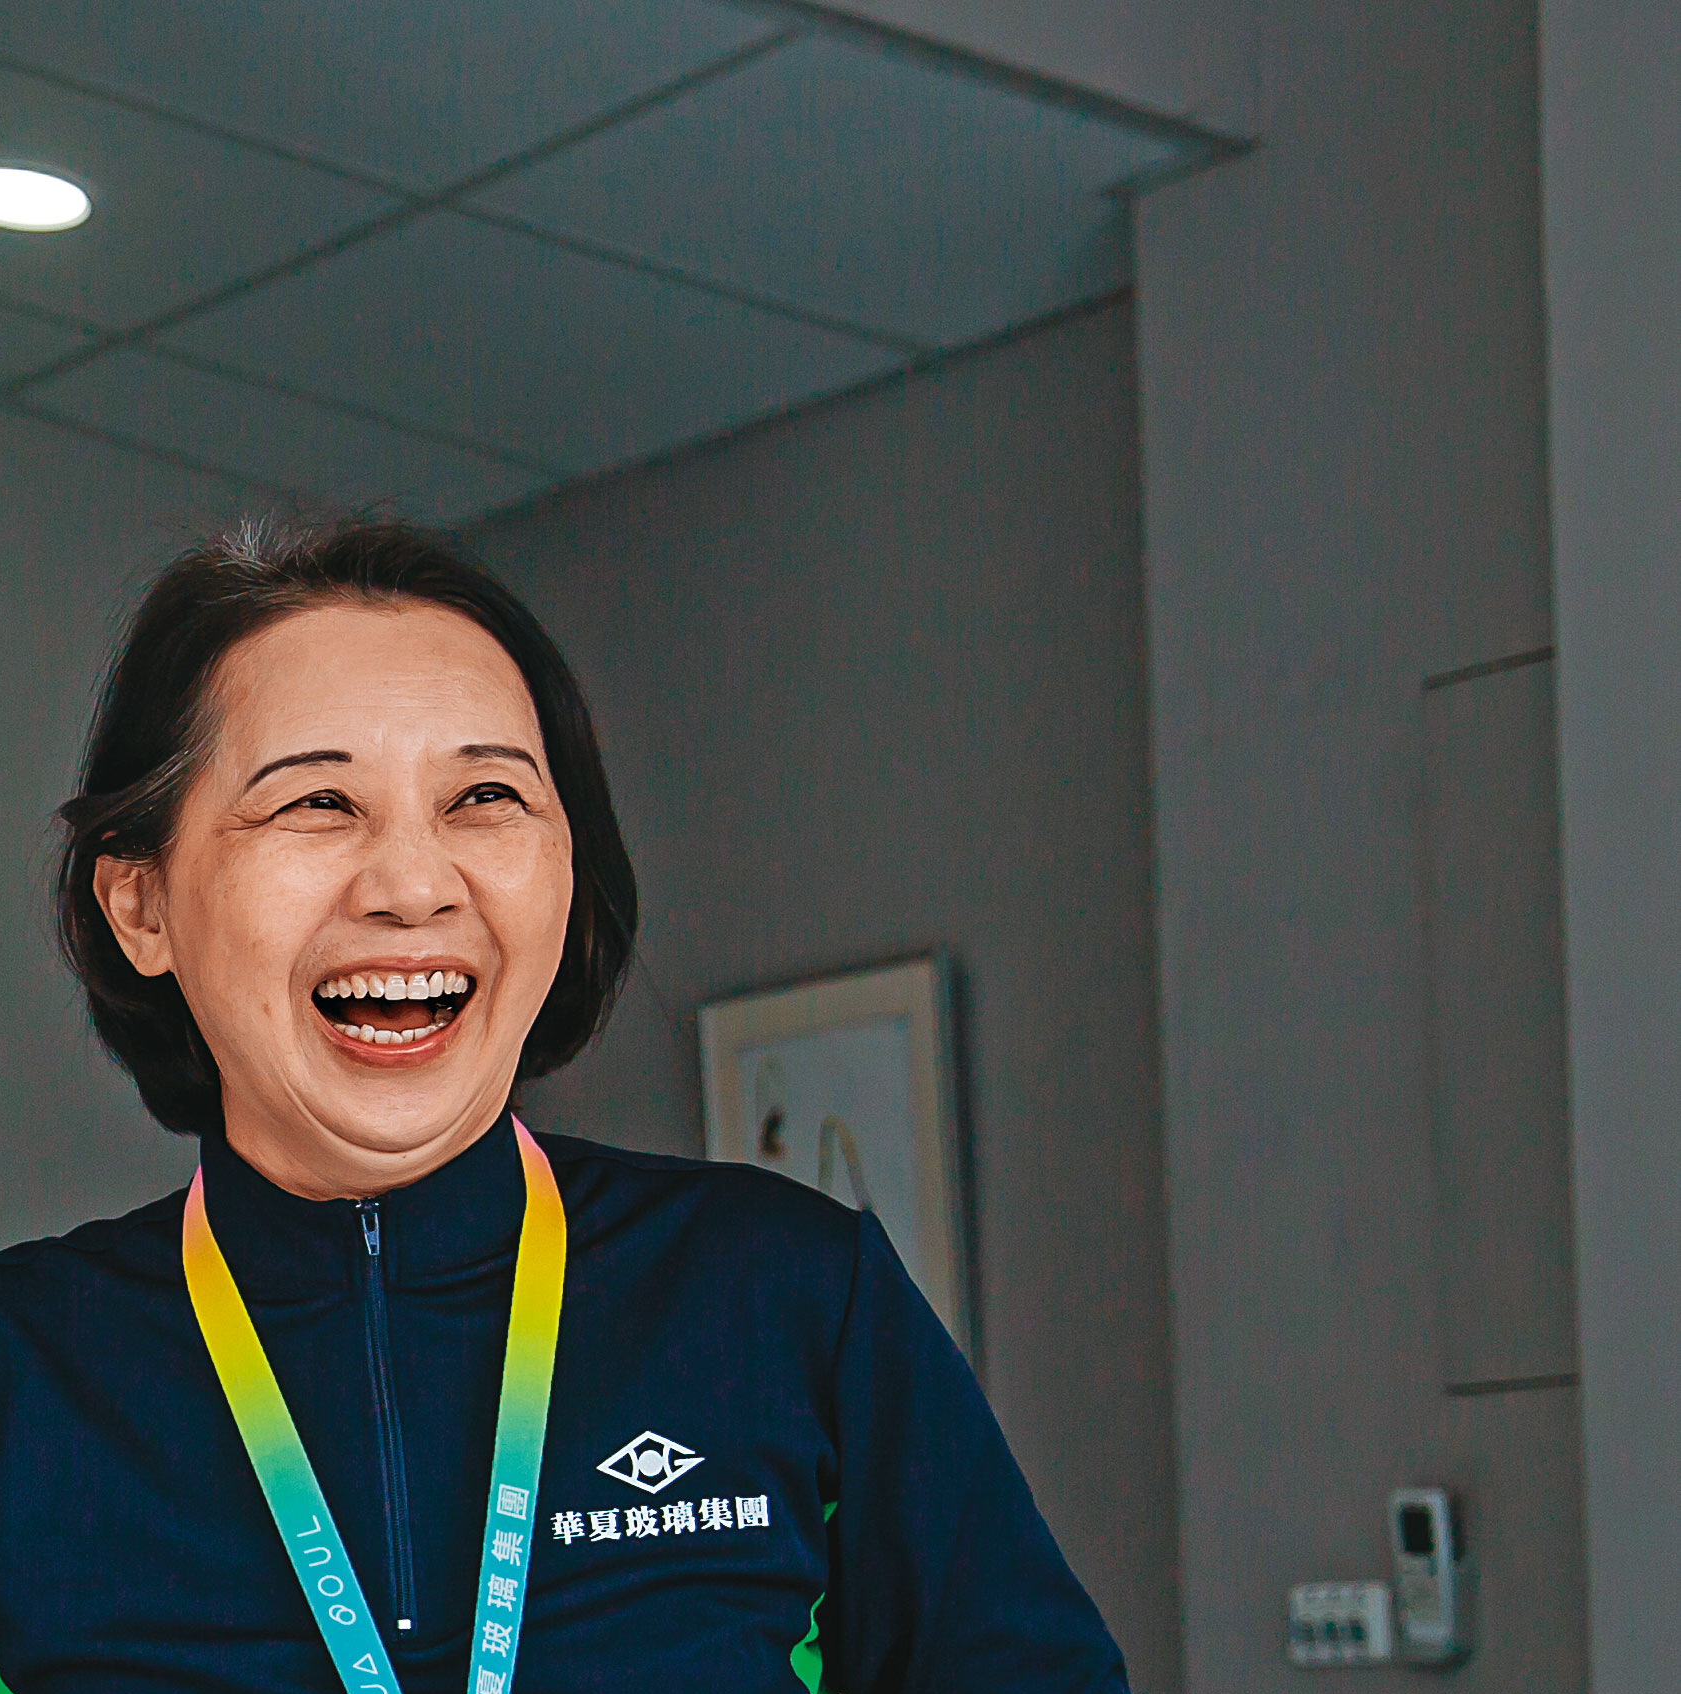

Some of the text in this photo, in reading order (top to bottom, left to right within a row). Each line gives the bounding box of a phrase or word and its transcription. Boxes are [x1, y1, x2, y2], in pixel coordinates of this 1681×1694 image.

[550, 1494, 770, 1546] 華夏玻璃集團
